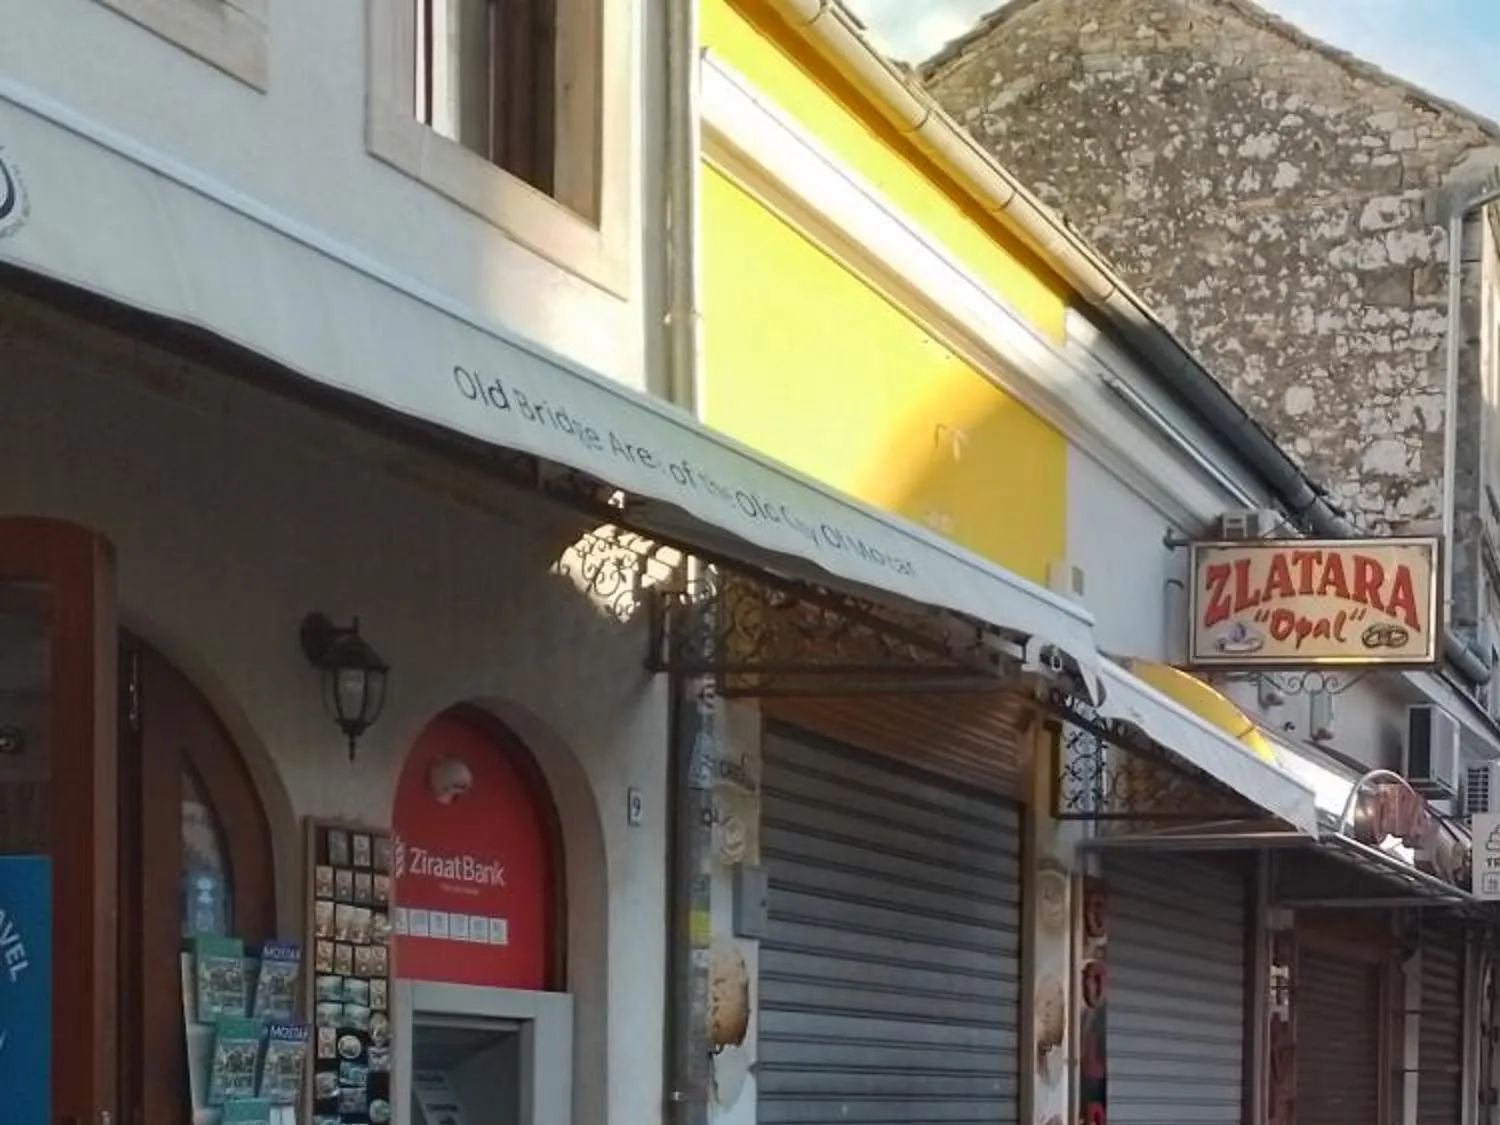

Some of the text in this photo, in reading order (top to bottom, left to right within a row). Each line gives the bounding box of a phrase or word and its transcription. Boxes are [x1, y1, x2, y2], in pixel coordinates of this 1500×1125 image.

[454, 366, 511, 412] Old
[1204, 550, 1421, 633] ZLATARA
[633, 796, 642, 817] 9
[409, 847, 506, 888] ZiraatBank
